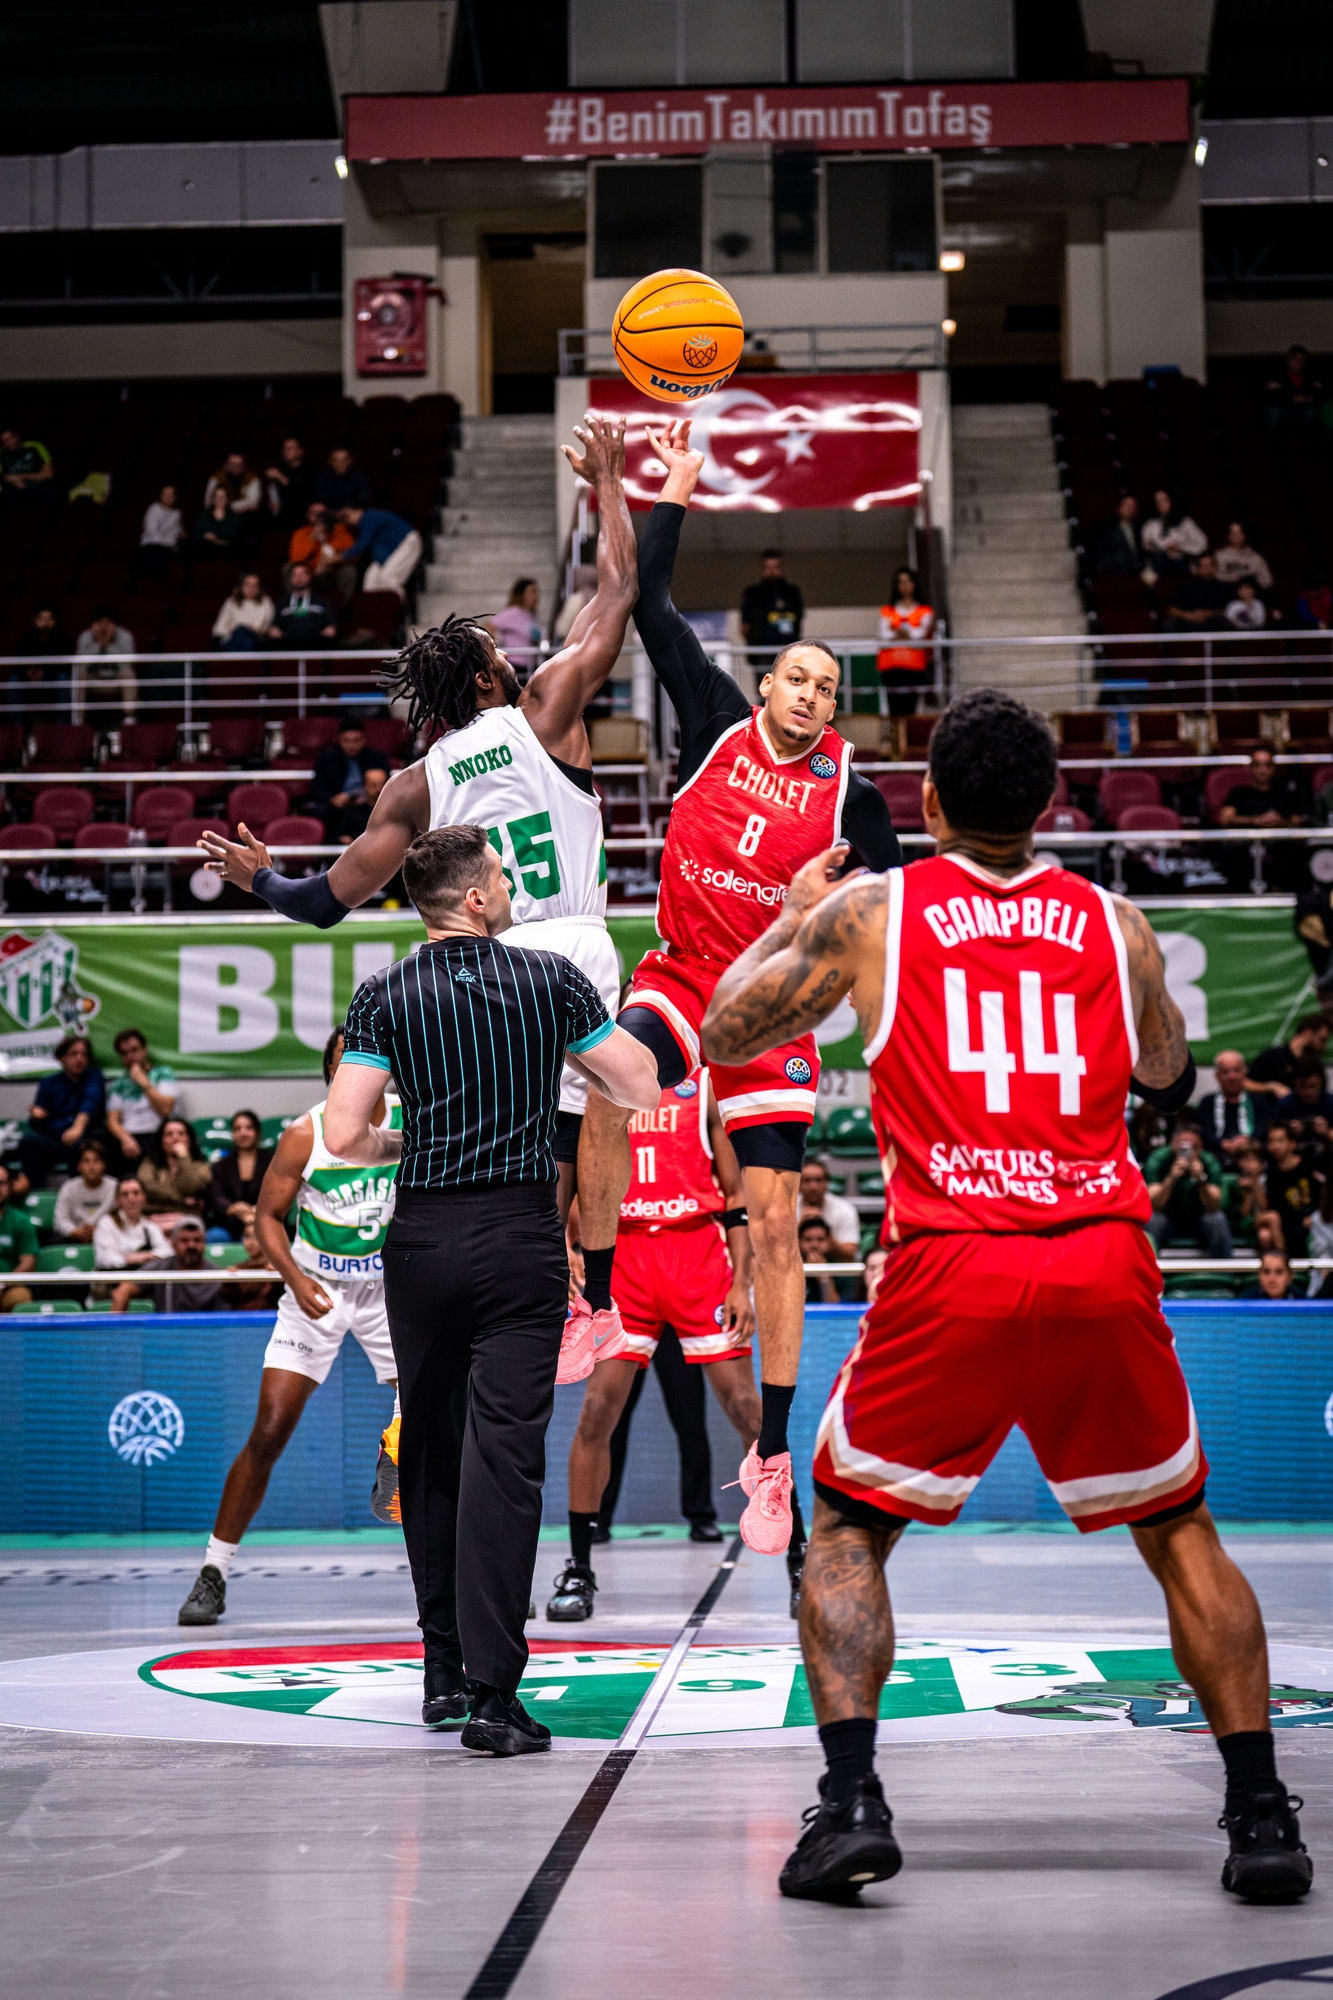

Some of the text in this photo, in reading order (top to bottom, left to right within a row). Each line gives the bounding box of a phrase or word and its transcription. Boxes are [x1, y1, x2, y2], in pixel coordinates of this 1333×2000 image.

[545, 90, 992, 146] #BenimTakımımTofaş
[448, 744, 513, 787] NNOKO
[727, 754, 817, 814] CHOLET
[737, 814, 767, 857] 8
[923, 895, 1089, 953] CAMPBELL
[943, 966, 1088, 1117] 44
[627, 1104, 682, 1134] HOLET
[636, 1146, 657, 1184] 11
[928, 1141, 1057, 1178] SAVEURS
[357, 1207, 384, 1241] 5
[619, 1194, 699, 1219] solengie
[318, 1253, 385, 1274] BURTO
